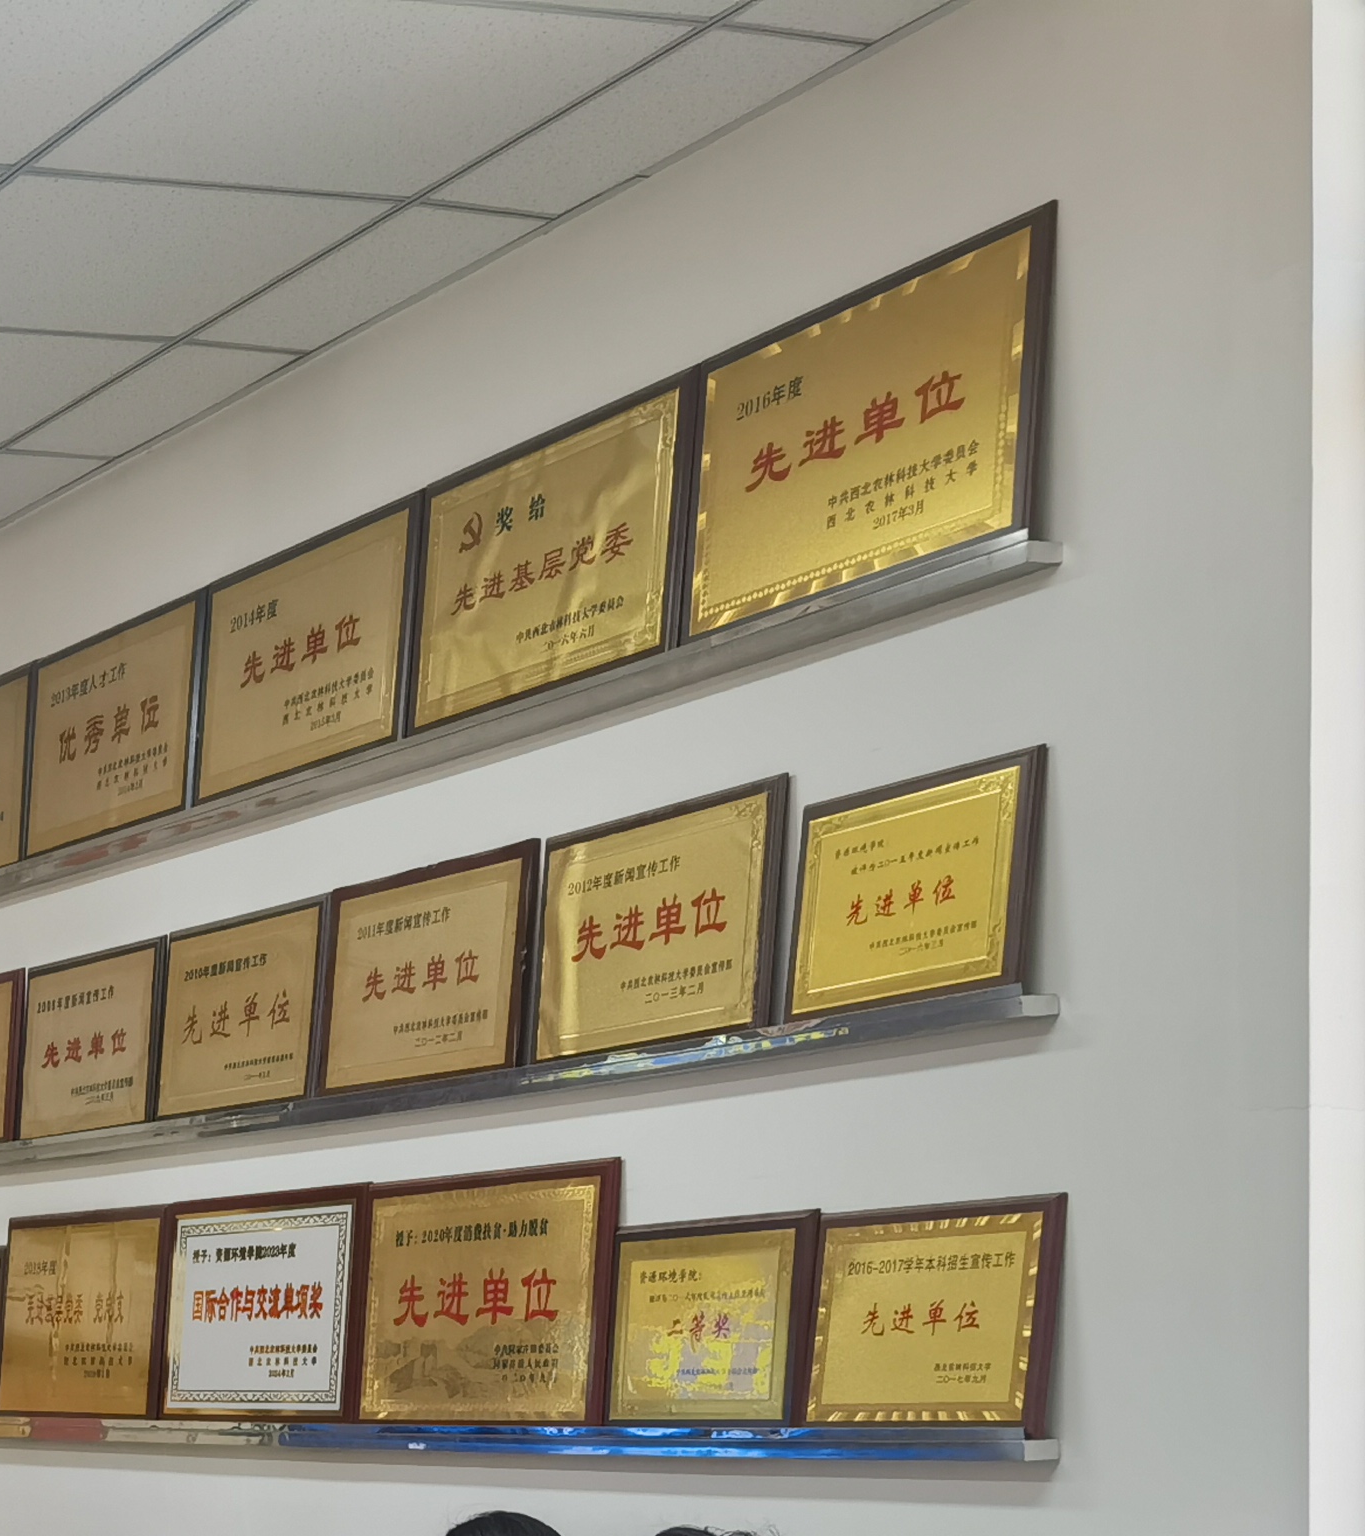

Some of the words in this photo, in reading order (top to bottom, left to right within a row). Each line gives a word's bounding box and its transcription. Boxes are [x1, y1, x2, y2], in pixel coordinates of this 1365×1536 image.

[735, 375, 804, 421] 2016年度
[745, 370, 966, 493] 先进单位
[826, 461, 978, 529] 西北农林科技大学
[827, 439, 980, 509] 中共西北农林科技大学委员会
[495, 494, 546, 536] 奖给
[872, 499, 925, 530] 2017年3月
[450, 522, 633, 616] 先进基层党委
[230, 599, 279, 633] 2014年度
[240, 612, 361, 689] 先进单位
[59, 695, 160, 763] 优秀单位
[567, 855, 681, 896] 2012年度新闻宣传工作
[356, 906, 451, 940] 2011年度新闻宣传工作
[845, 874, 956, 927] 先进单位
[571, 887, 727, 962] 先进单位
[362, 949, 479, 1003] 先进单位
[620, 958, 733, 991] 中共西北农林科技大学委员会宣传部
[182, 989, 290, 1046] 先进单位
[41, 1028, 127, 1070] 先进单位
[847, 1251, 1016, 1277] 2016-2017学年本科招生宣传工作
[192, 1281, 323, 1324] 国际合作与交流单项奖
[393, 1267, 559, 1327] 先进单位
[861, 1299, 980, 1337] 先进单位
[667, 1311, 730, 1352] 二等奖
